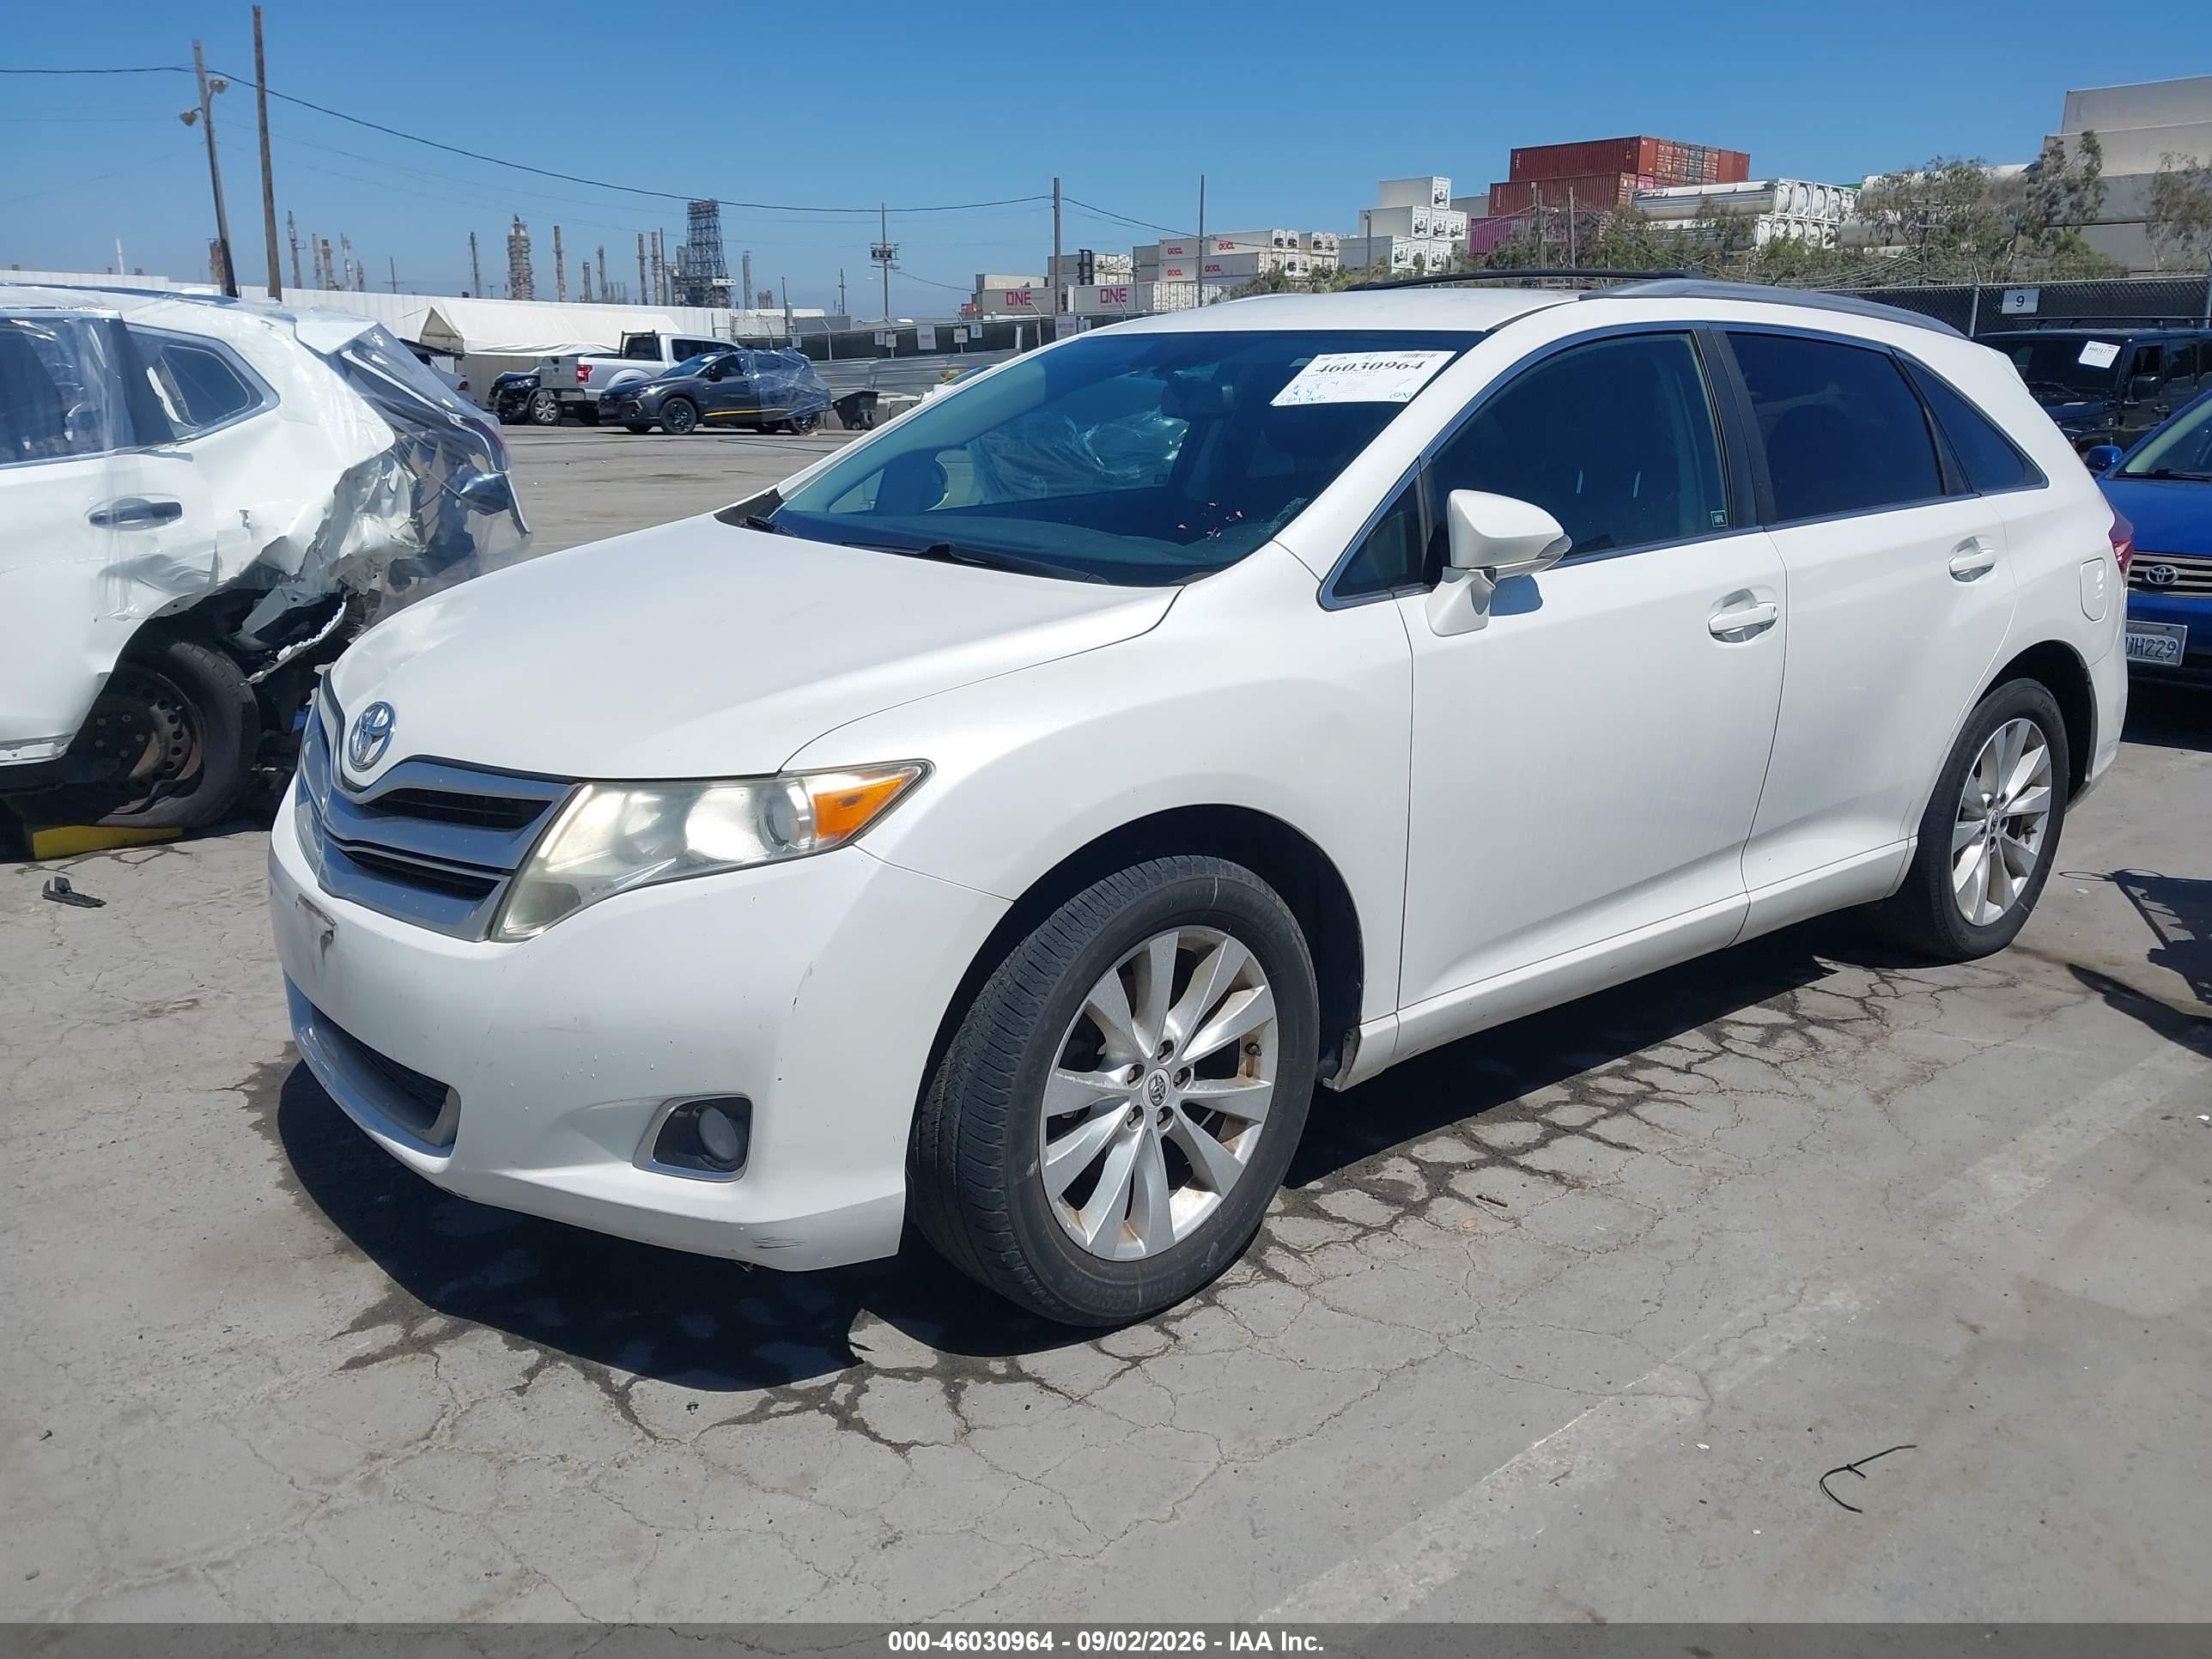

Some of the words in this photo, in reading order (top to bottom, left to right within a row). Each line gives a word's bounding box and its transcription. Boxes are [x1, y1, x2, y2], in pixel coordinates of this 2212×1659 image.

[1218, 242, 1235, 251] OOCL
[1006, 291, 1031, 306] ONE
[1100, 288, 1127, 304] ONE
[2015, 295, 2025, 307] 9
[1316, 360, 1426, 374] 46030964
